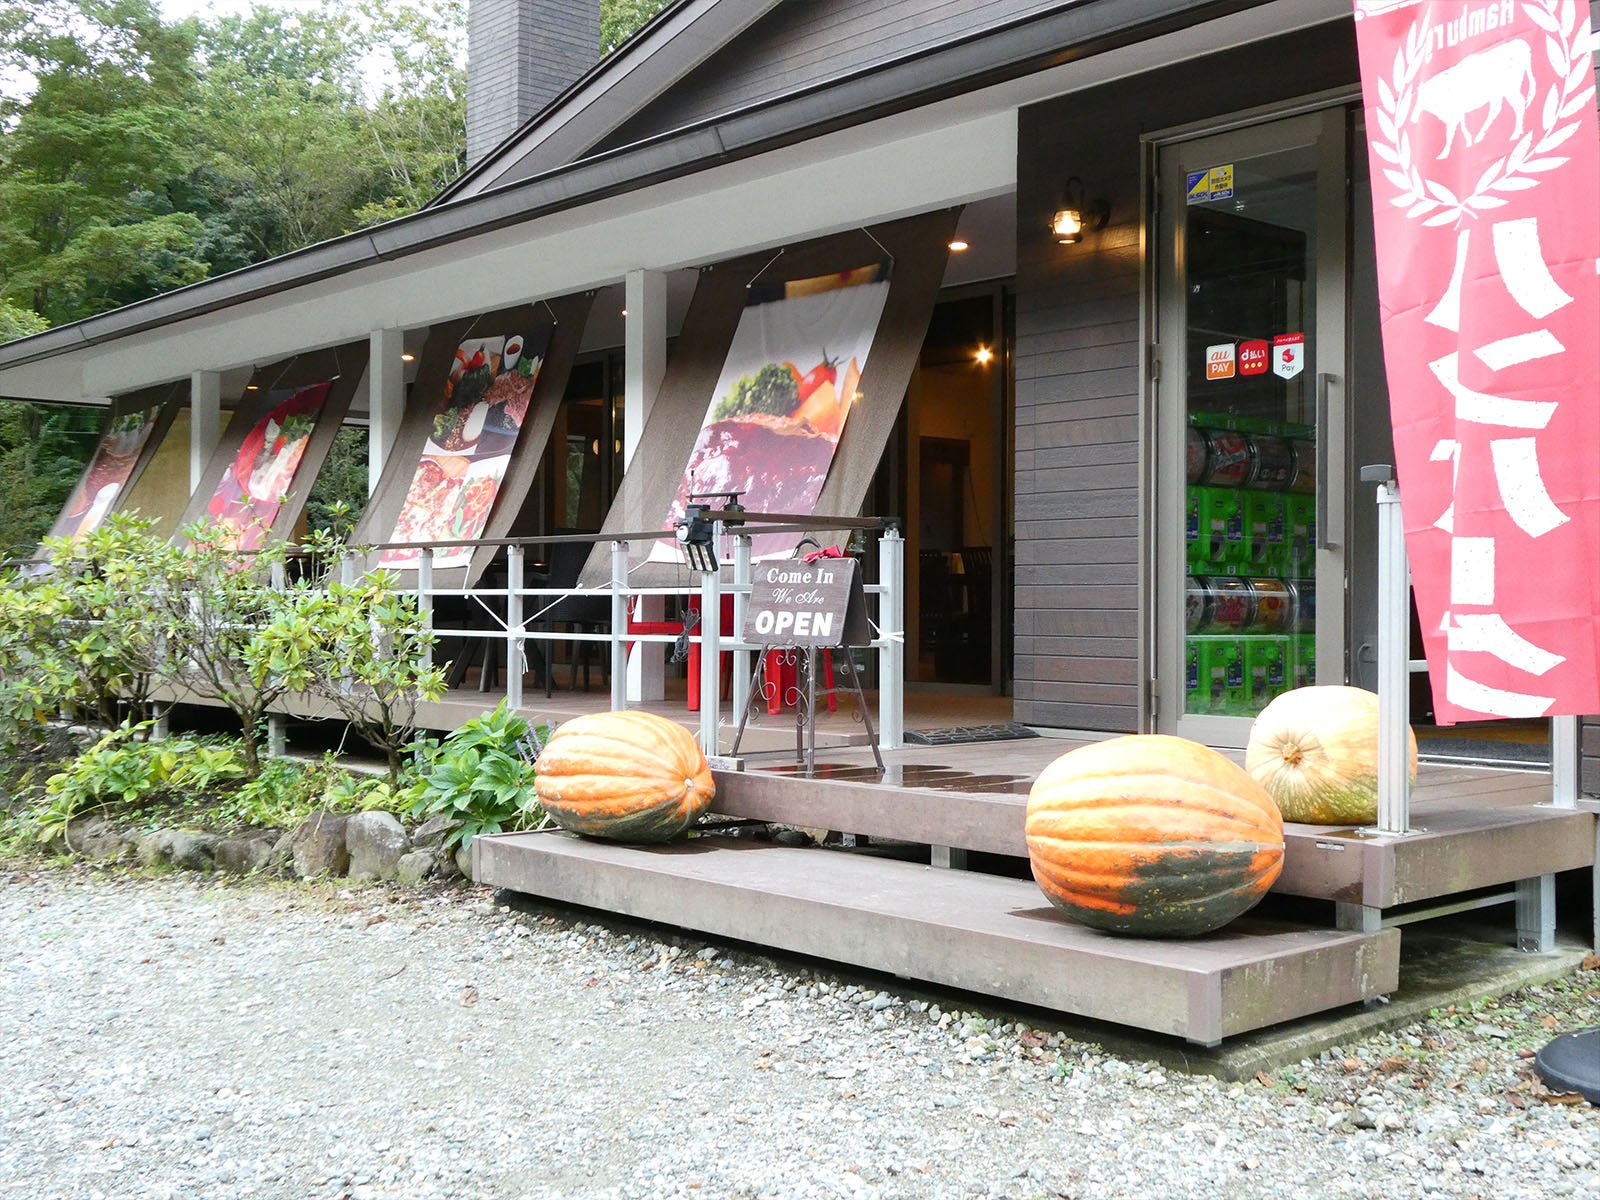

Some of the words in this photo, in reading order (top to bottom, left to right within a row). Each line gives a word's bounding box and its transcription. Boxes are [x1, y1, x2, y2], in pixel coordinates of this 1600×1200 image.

[1211, 350, 1230, 361] au
[1241, 349, 1265, 360] d払い
[1212, 363, 1229, 373] PAY
[1282, 364, 1295, 372] Pay
[767, 568, 812, 584] Come
[815, 568, 834, 584] In
[772, 588, 794, 604] We
[795, 588, 825, 604] Are
[755, 610, 833, 637] OPEN
